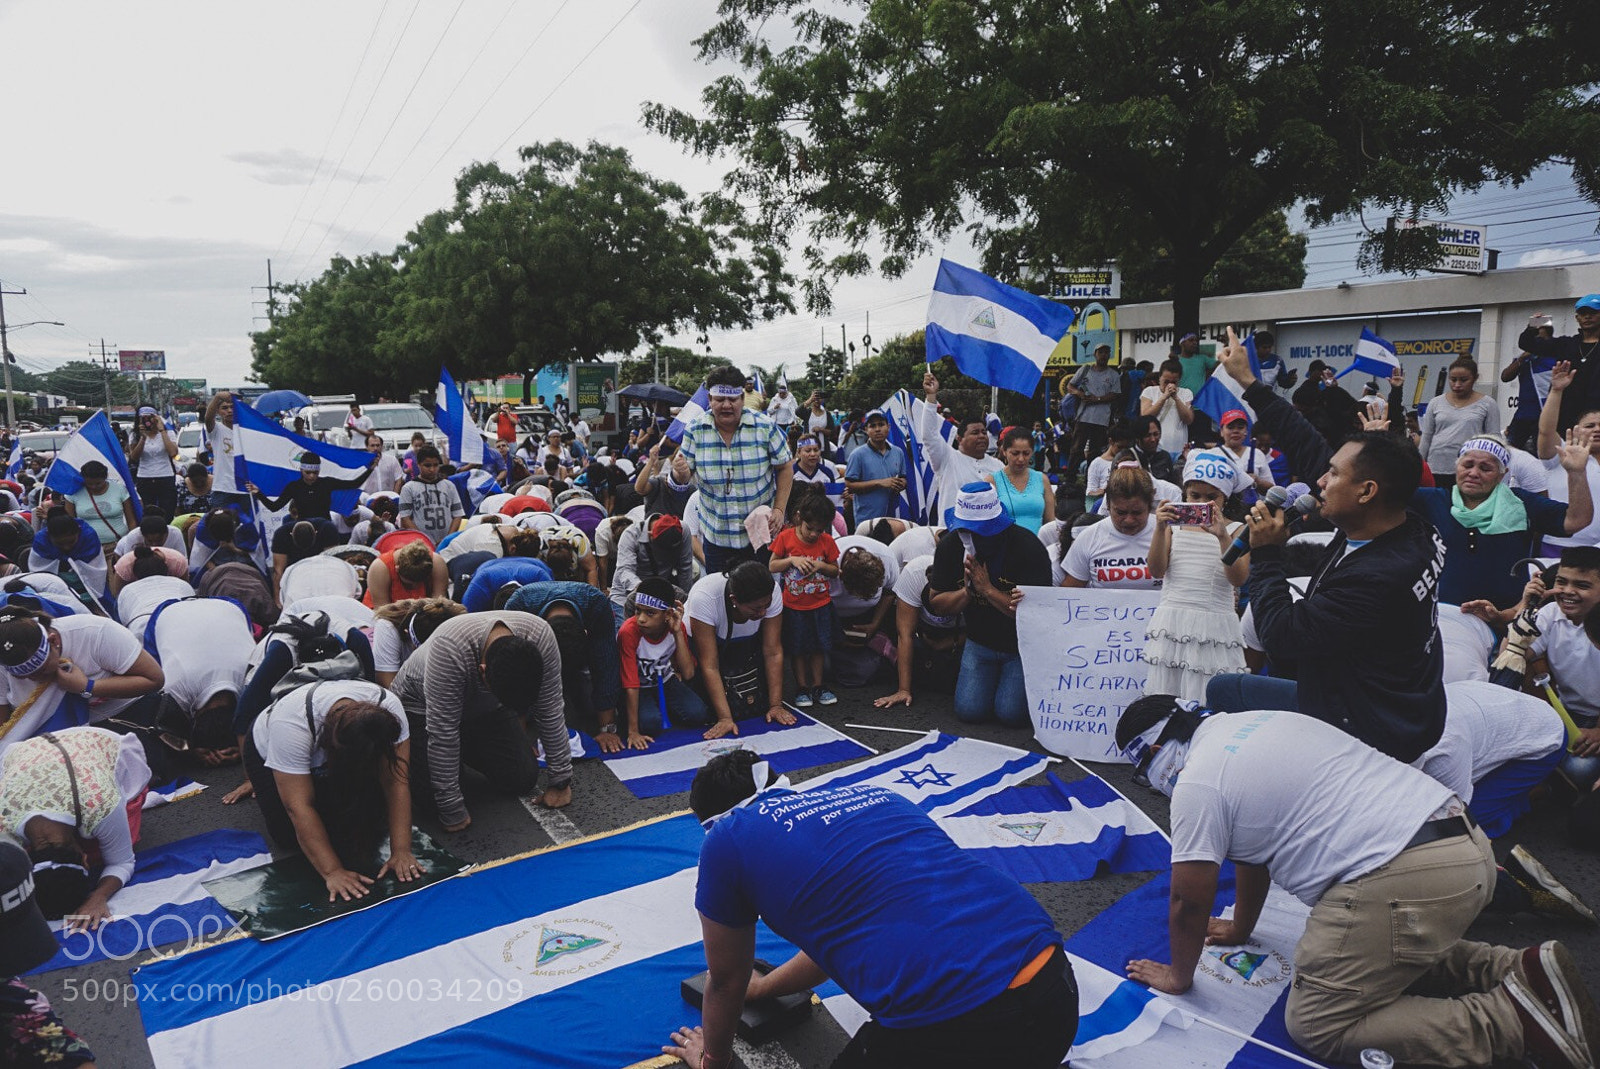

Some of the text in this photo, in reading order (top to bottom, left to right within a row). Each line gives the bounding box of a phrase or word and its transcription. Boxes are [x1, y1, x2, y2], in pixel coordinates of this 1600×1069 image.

[1441, 245, 1479, 256] TOMOTRIZ
[1135, 327, 1174, 343] HOSPIT
[1290, 344, 1353, 358] MUL-T-LOCK
[1403, 340, 1461, 354] MONROE
[424, 507, 446, 530] 58
[1094, 557, 1148, 567] NICARA
[821, 809, 842, 825] por
[784, 819, 793, 832] y
